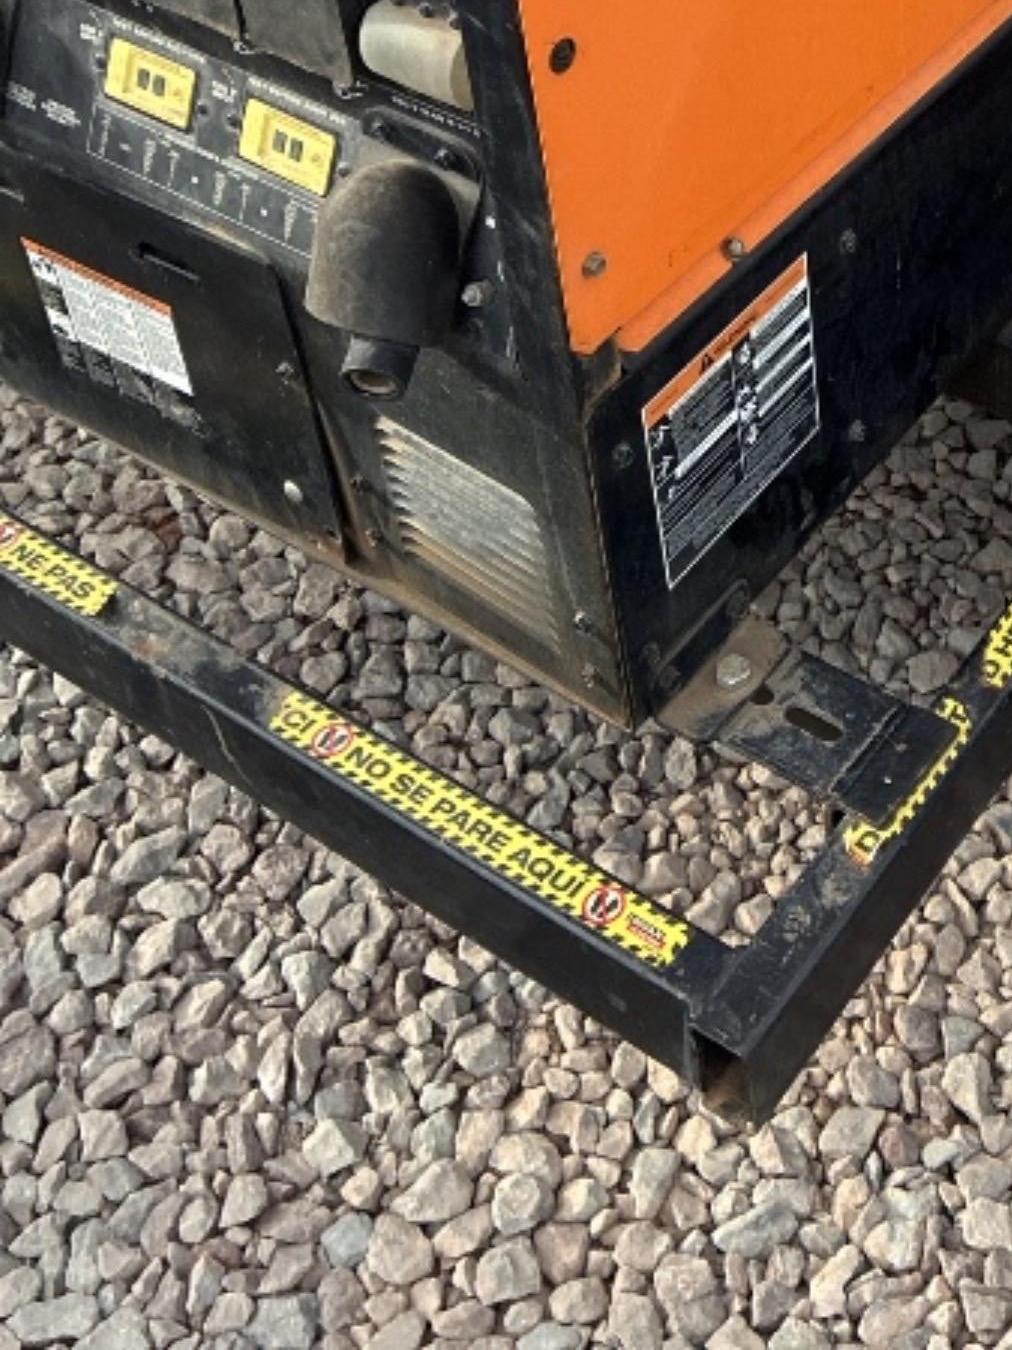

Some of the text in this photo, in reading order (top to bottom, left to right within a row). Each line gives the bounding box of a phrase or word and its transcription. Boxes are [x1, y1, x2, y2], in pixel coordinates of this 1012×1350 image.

[16, 543, 97, 599] NE PAS
[344, 745, 392, 779] NO
[389, 773, 431, 806] SE
[429, 796, 514, 853] PARE
